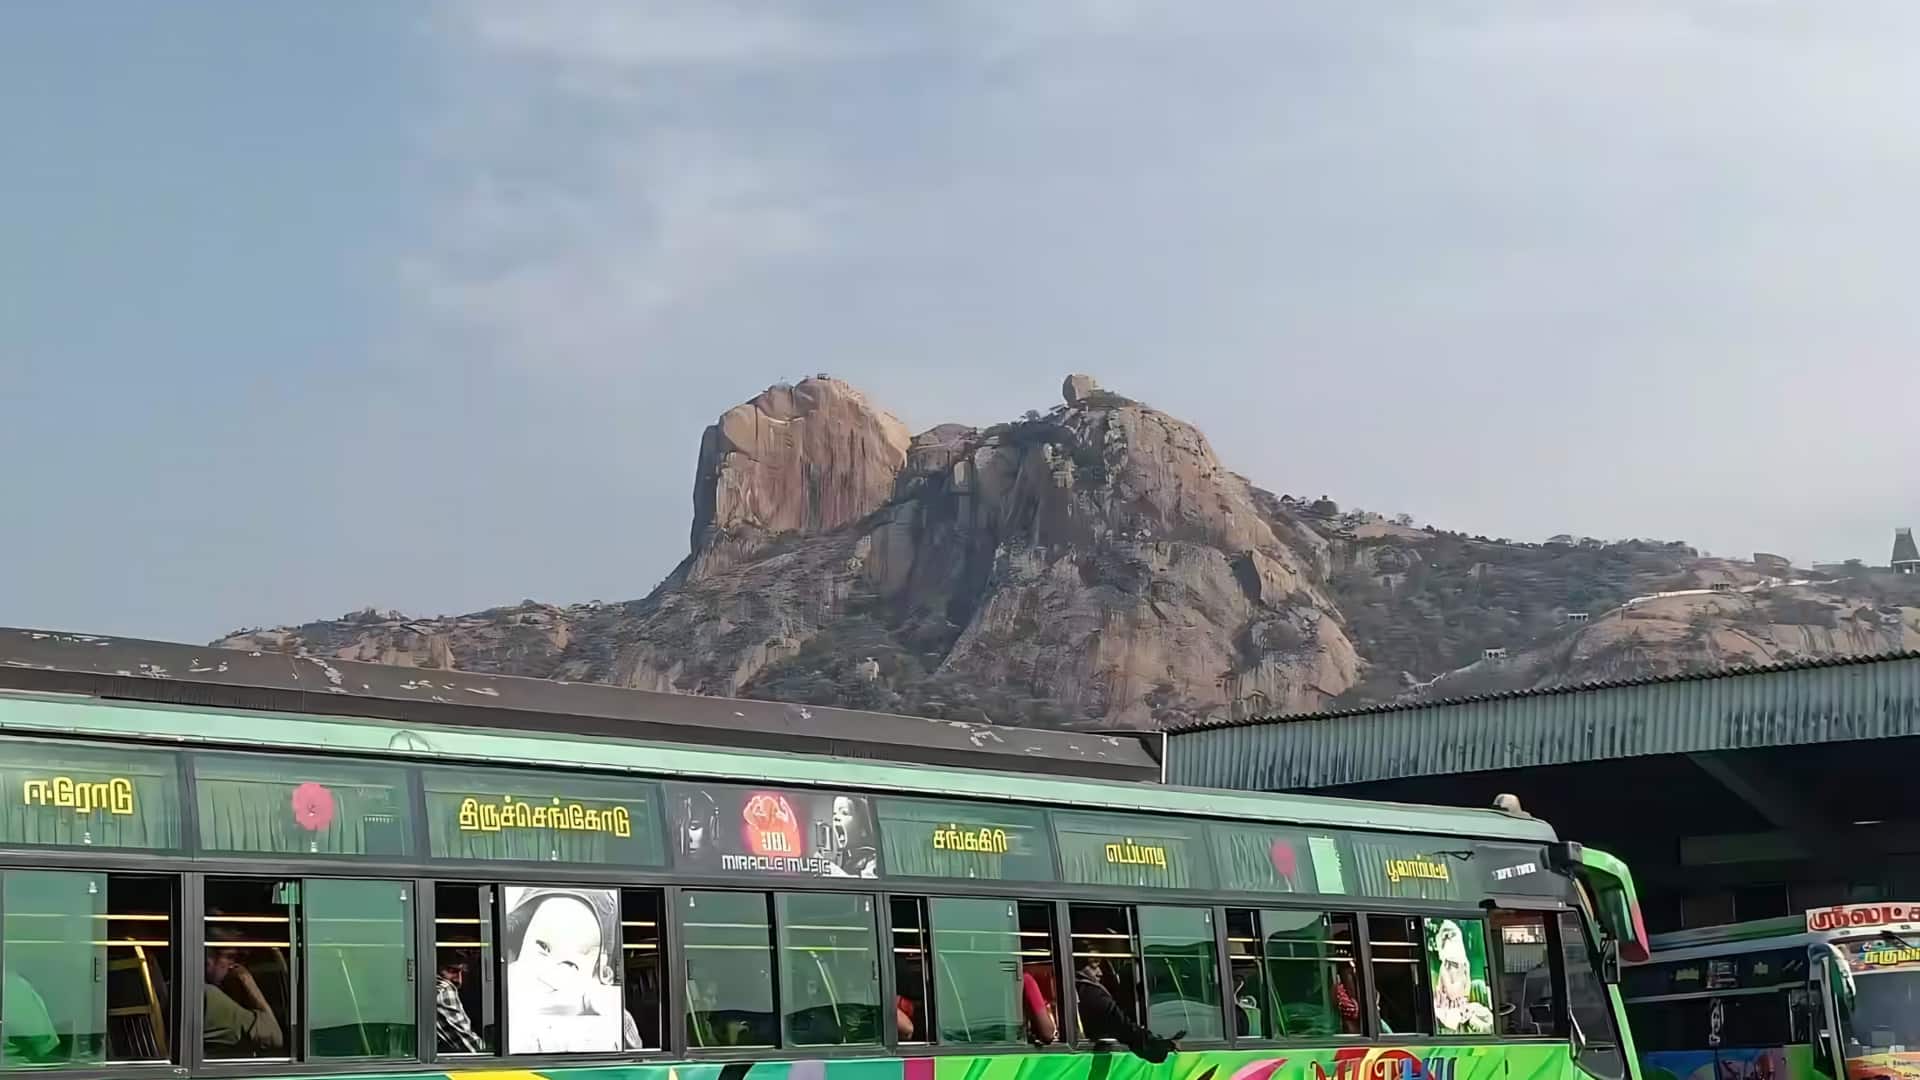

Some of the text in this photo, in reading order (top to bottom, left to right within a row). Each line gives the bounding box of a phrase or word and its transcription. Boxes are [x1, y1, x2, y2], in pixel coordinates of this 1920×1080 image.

[23, 776, 133, 815] ஈரோடு
[459, 795, 631, 838] திருச்செங்கோடு
[933, 824, 1008, 854] சங்ககிரி
[1105, 838, 1167, 869] எடப்பாடி
[722, 855, 784, 871] MIRACLE
